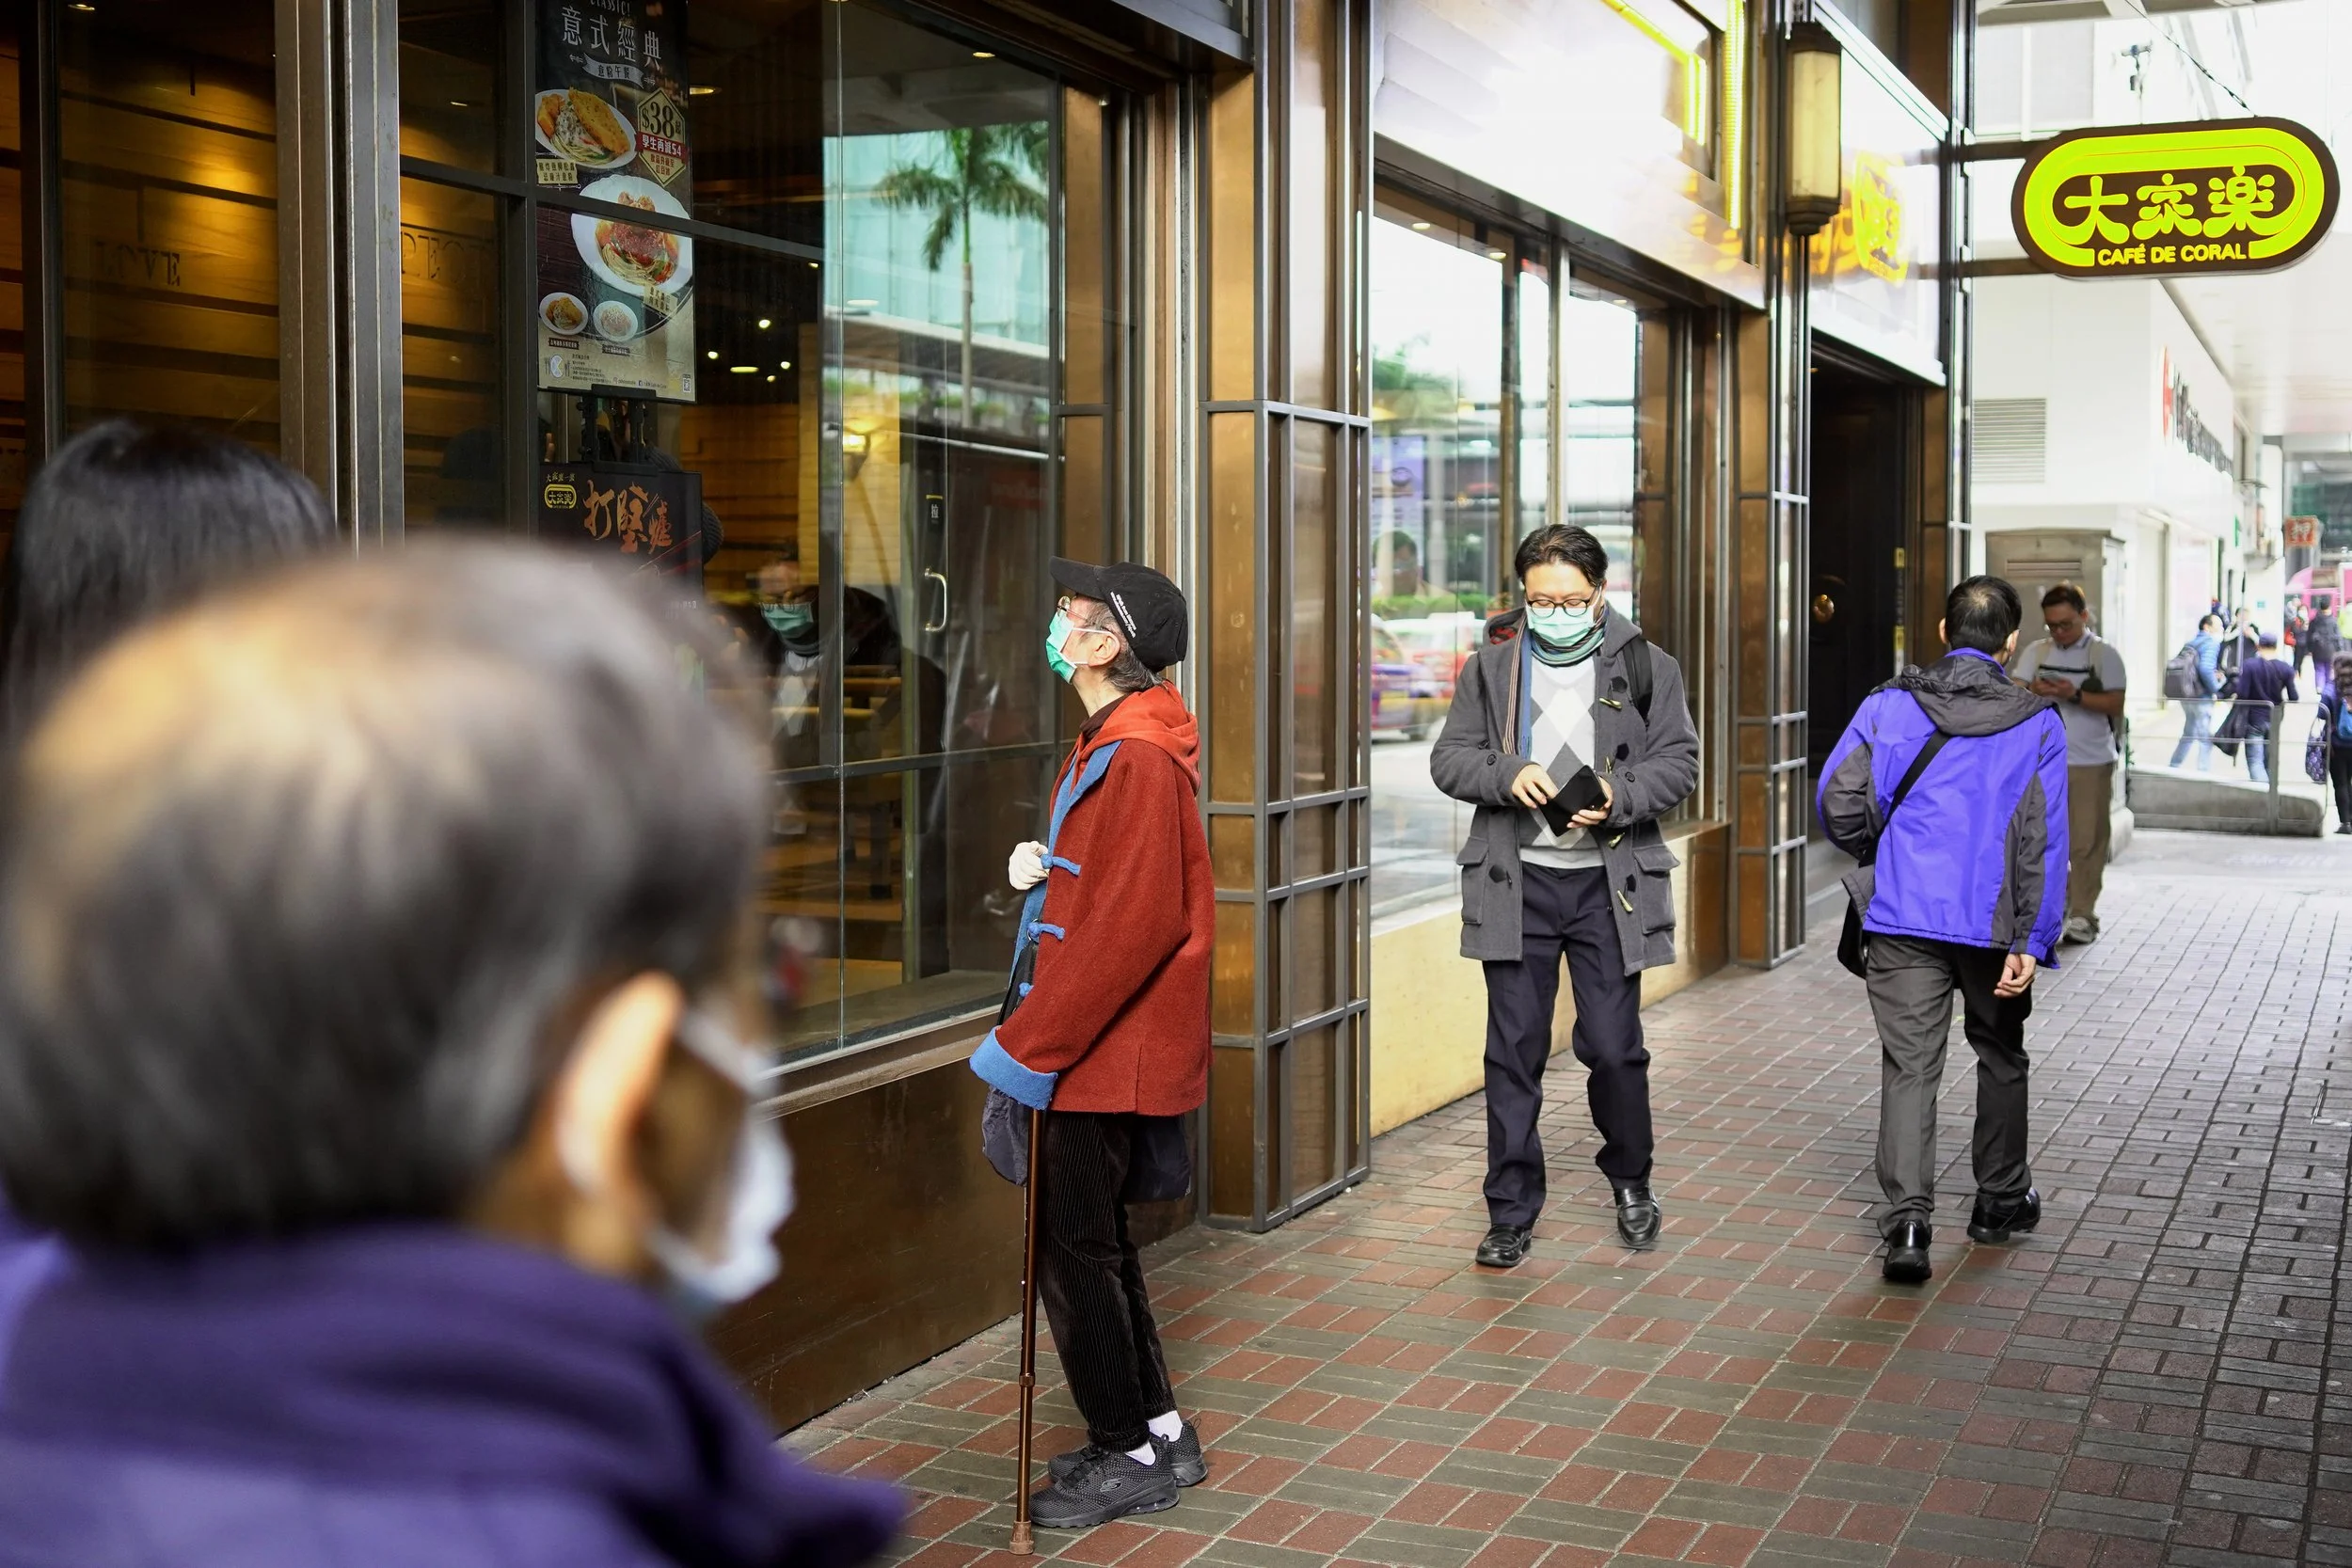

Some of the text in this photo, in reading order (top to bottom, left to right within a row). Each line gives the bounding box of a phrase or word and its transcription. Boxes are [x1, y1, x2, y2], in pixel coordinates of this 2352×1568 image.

[562, 6, 661, 71] 意式經典
[597, 64, 630, 79] 意粉午餐
[2097, 243, 2247, 266] CAFÉ DE CORAL
